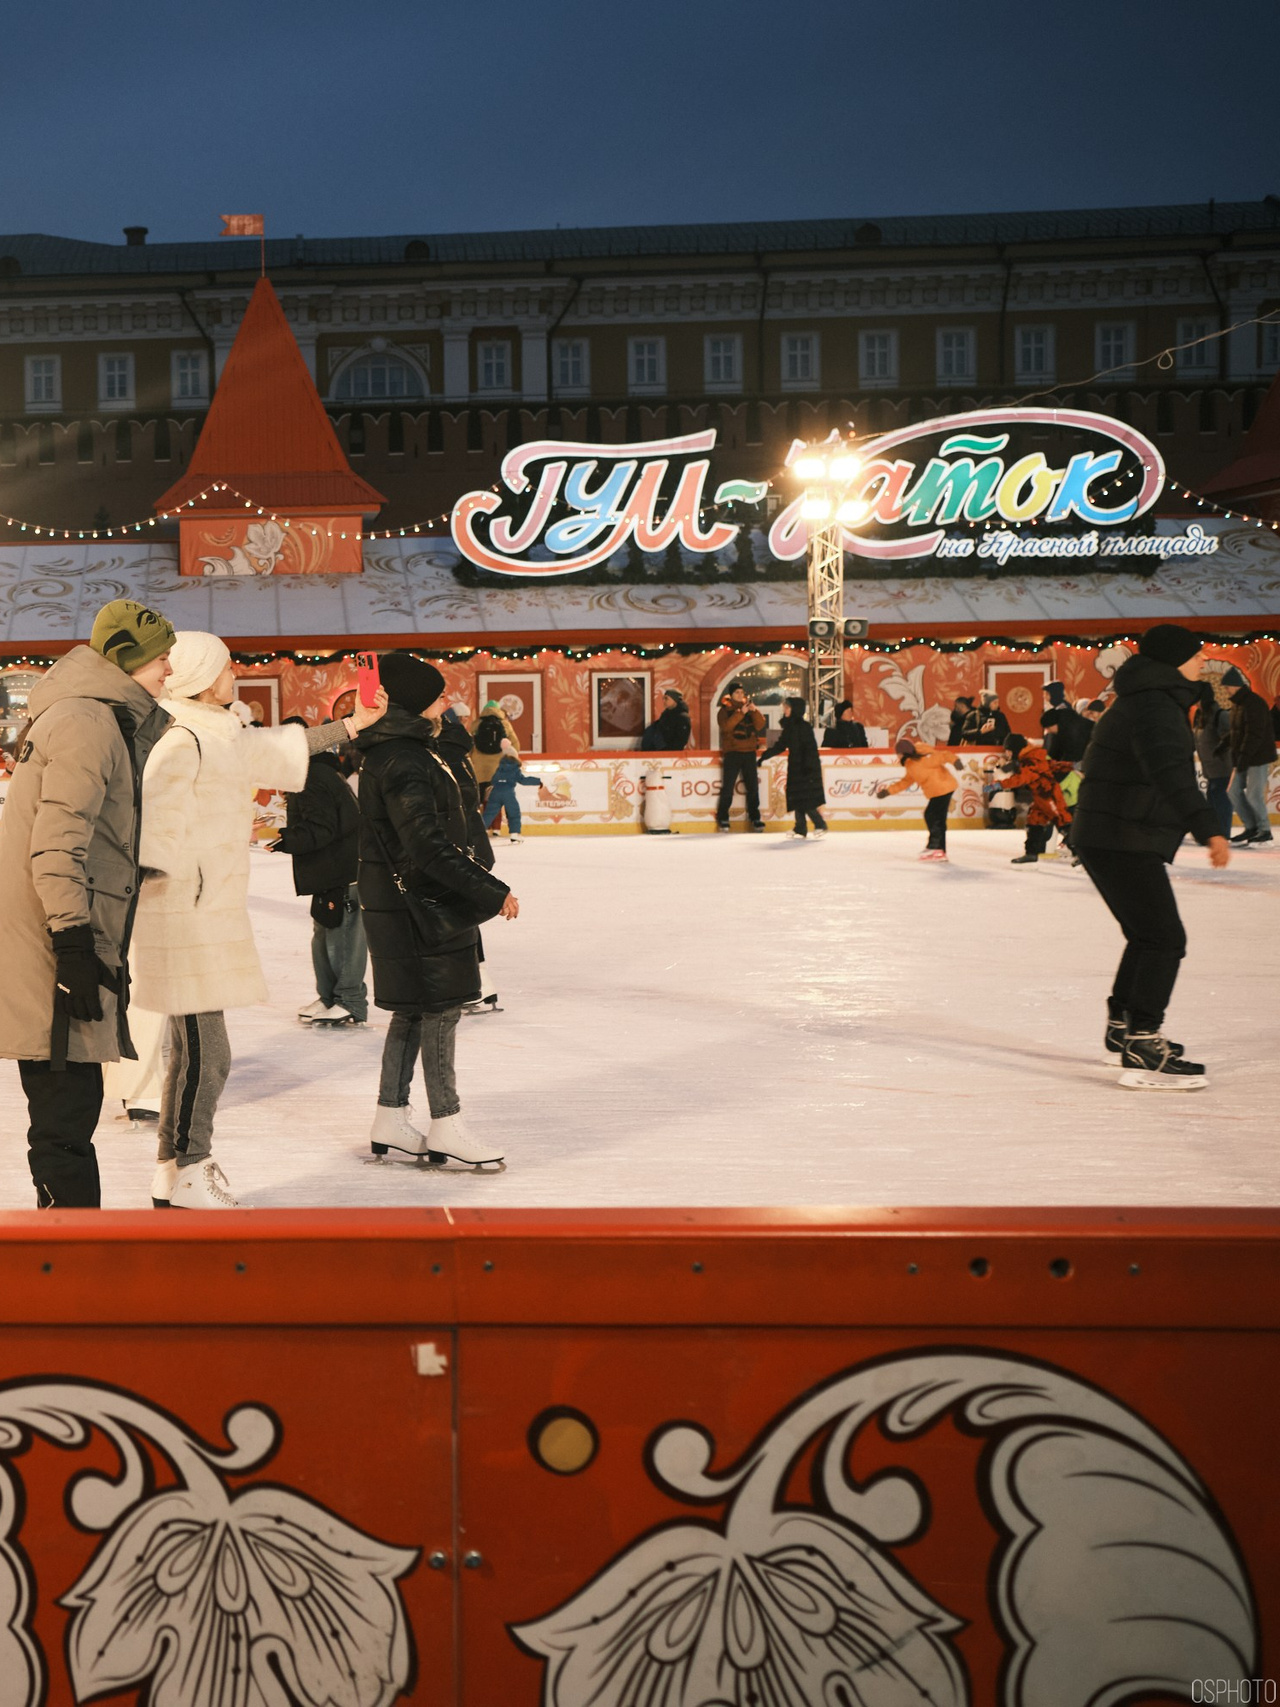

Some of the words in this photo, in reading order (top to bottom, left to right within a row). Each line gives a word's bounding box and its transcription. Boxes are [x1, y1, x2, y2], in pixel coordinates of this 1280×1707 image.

[937, 537, 975, 558] на
[976, 529, 1099, 566] Красной
[1099, 523, 1219, 560] площади
[681, 780, 746, 798] BOSO
